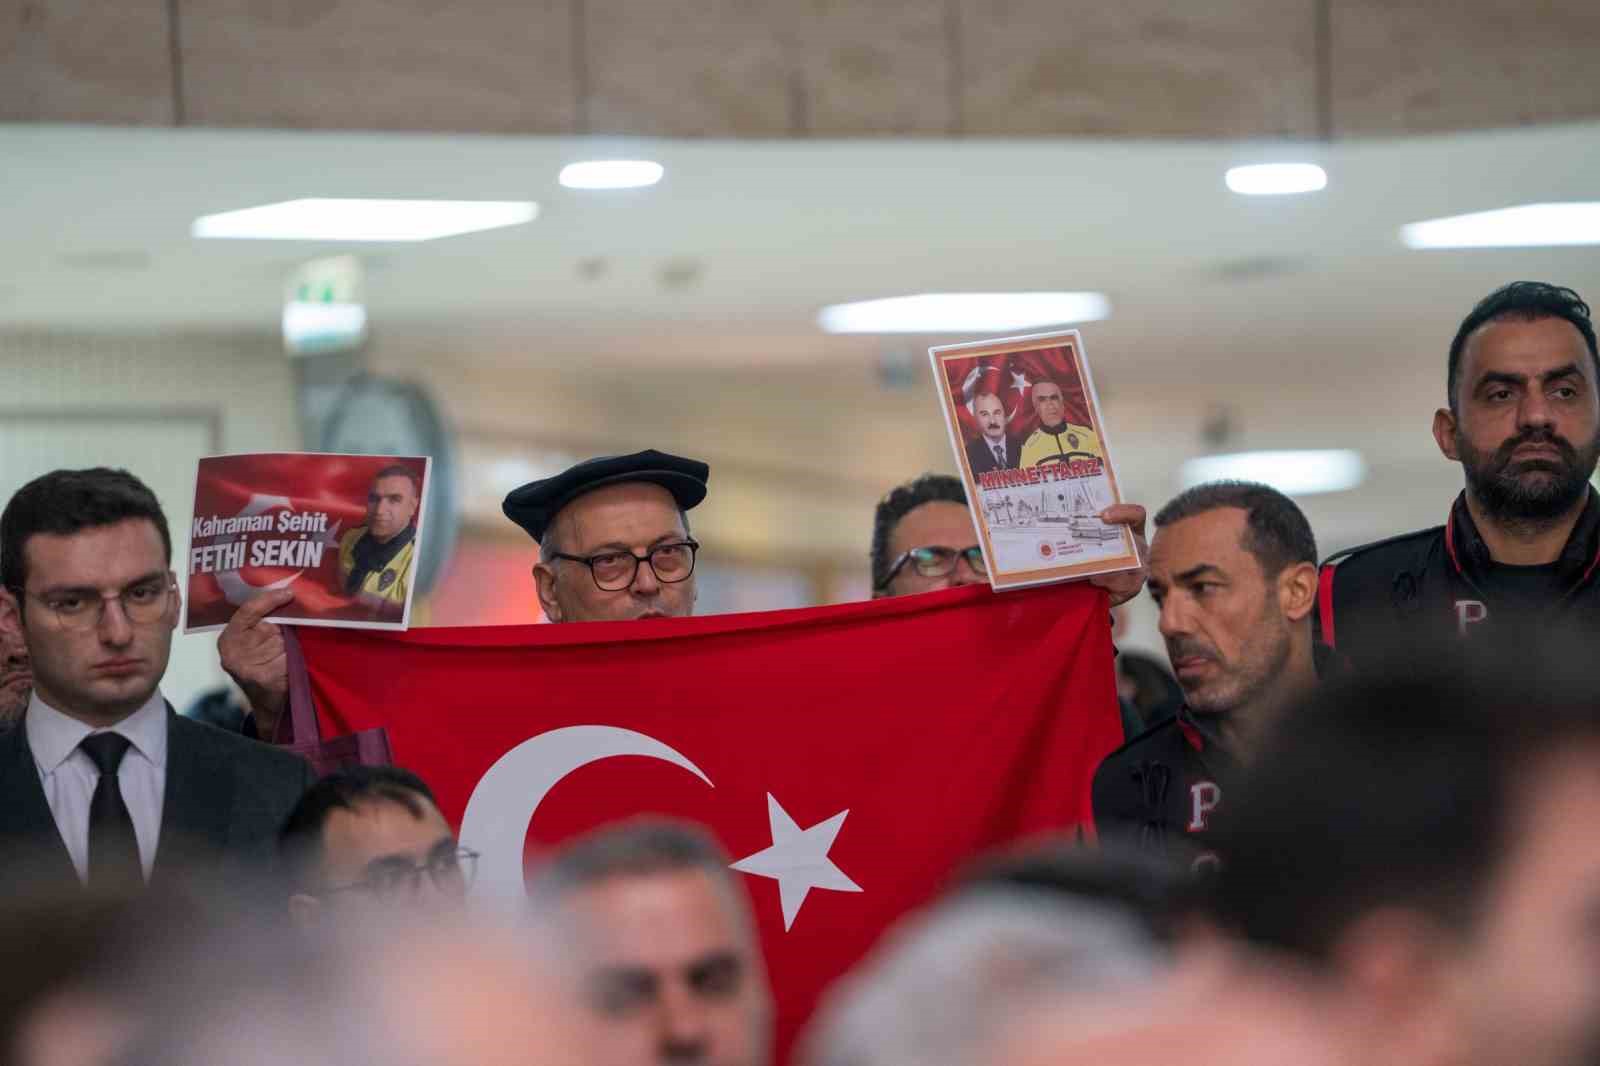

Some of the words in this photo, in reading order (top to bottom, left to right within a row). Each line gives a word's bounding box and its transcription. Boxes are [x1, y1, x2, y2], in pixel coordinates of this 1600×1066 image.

[192, 513, 273, 538] Kahraman
[277, 511, 328, 533] Şehit
[190, 535, 247, 574] FETHİ
[250, 534, 323, 568] SEKİN
